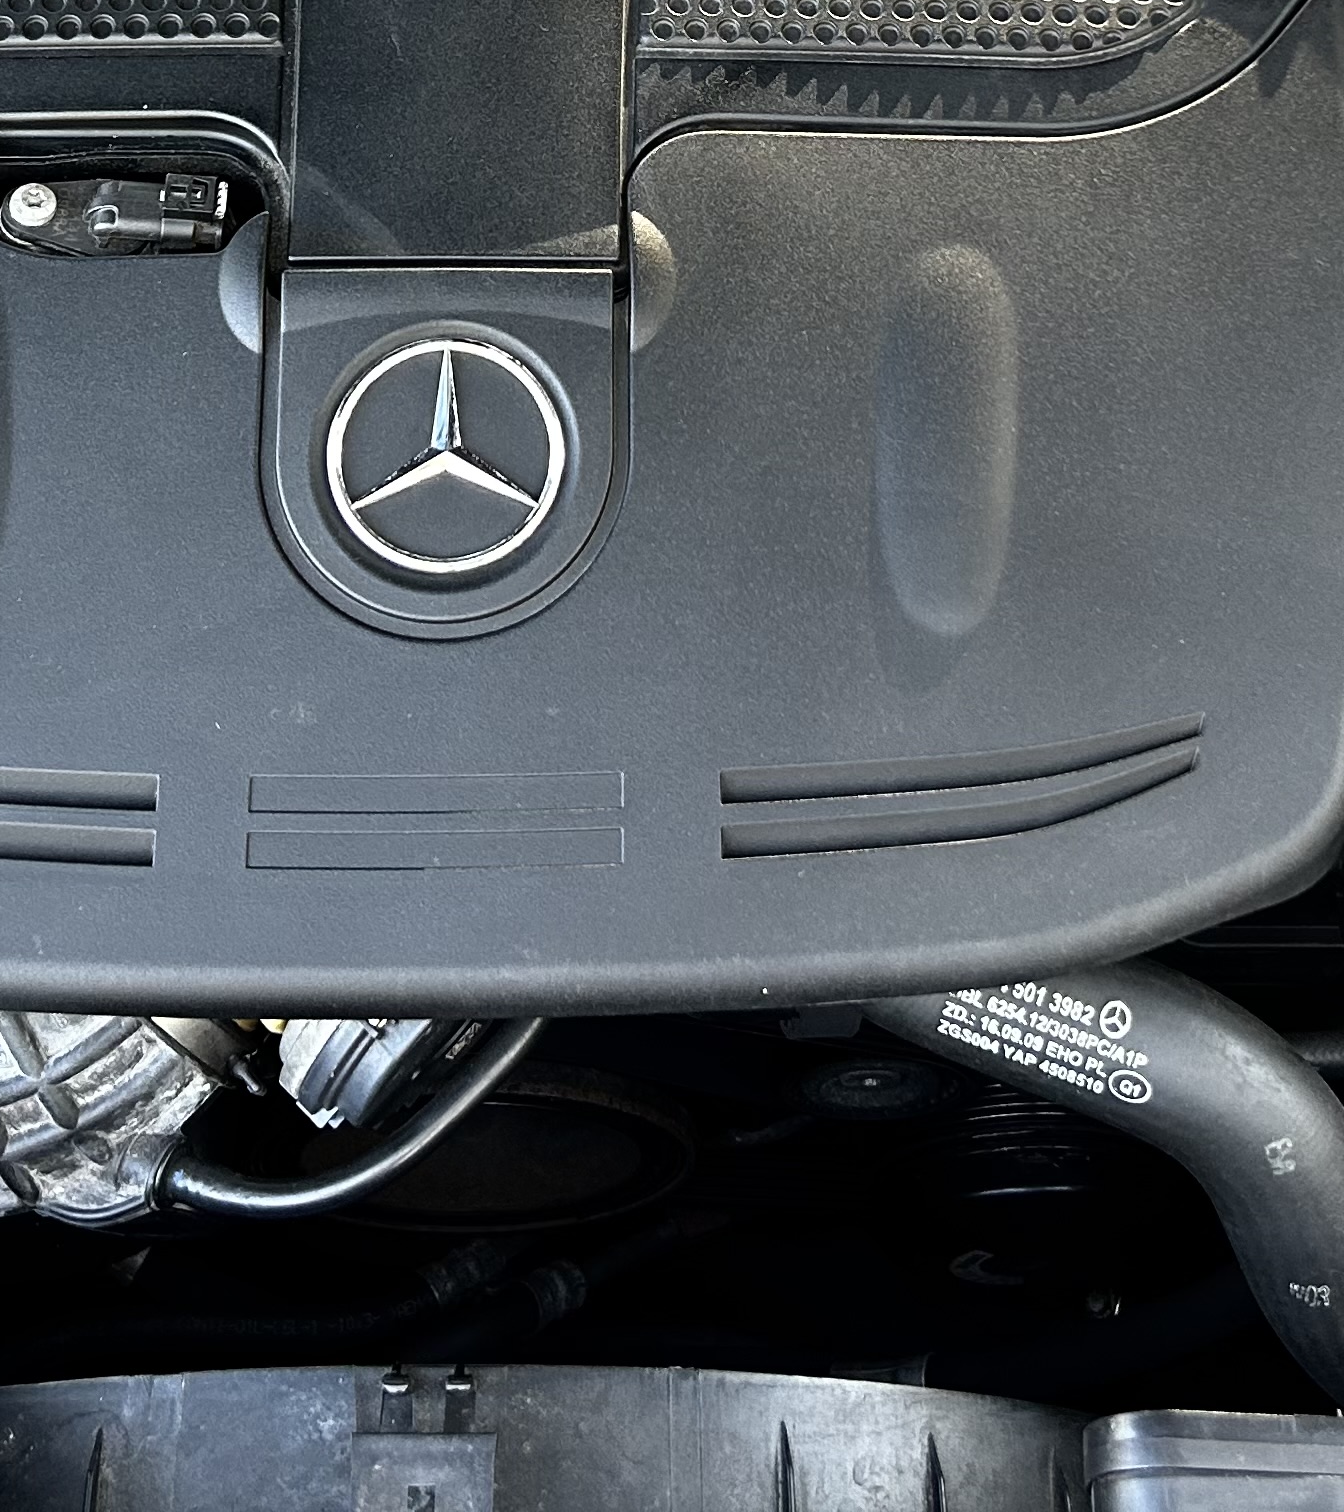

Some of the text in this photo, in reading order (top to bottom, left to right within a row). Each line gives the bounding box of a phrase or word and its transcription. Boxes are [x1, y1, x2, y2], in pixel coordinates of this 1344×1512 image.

[1049, 992, 1095, 1026] 3982
[937, 1019, 1000, 1054] ZGS004
[1003, 1043, 1038, 1066] YAP
[1046, 1040, 1083, 1067] EHO
[1085, 1056, 1107, 1078] PL
